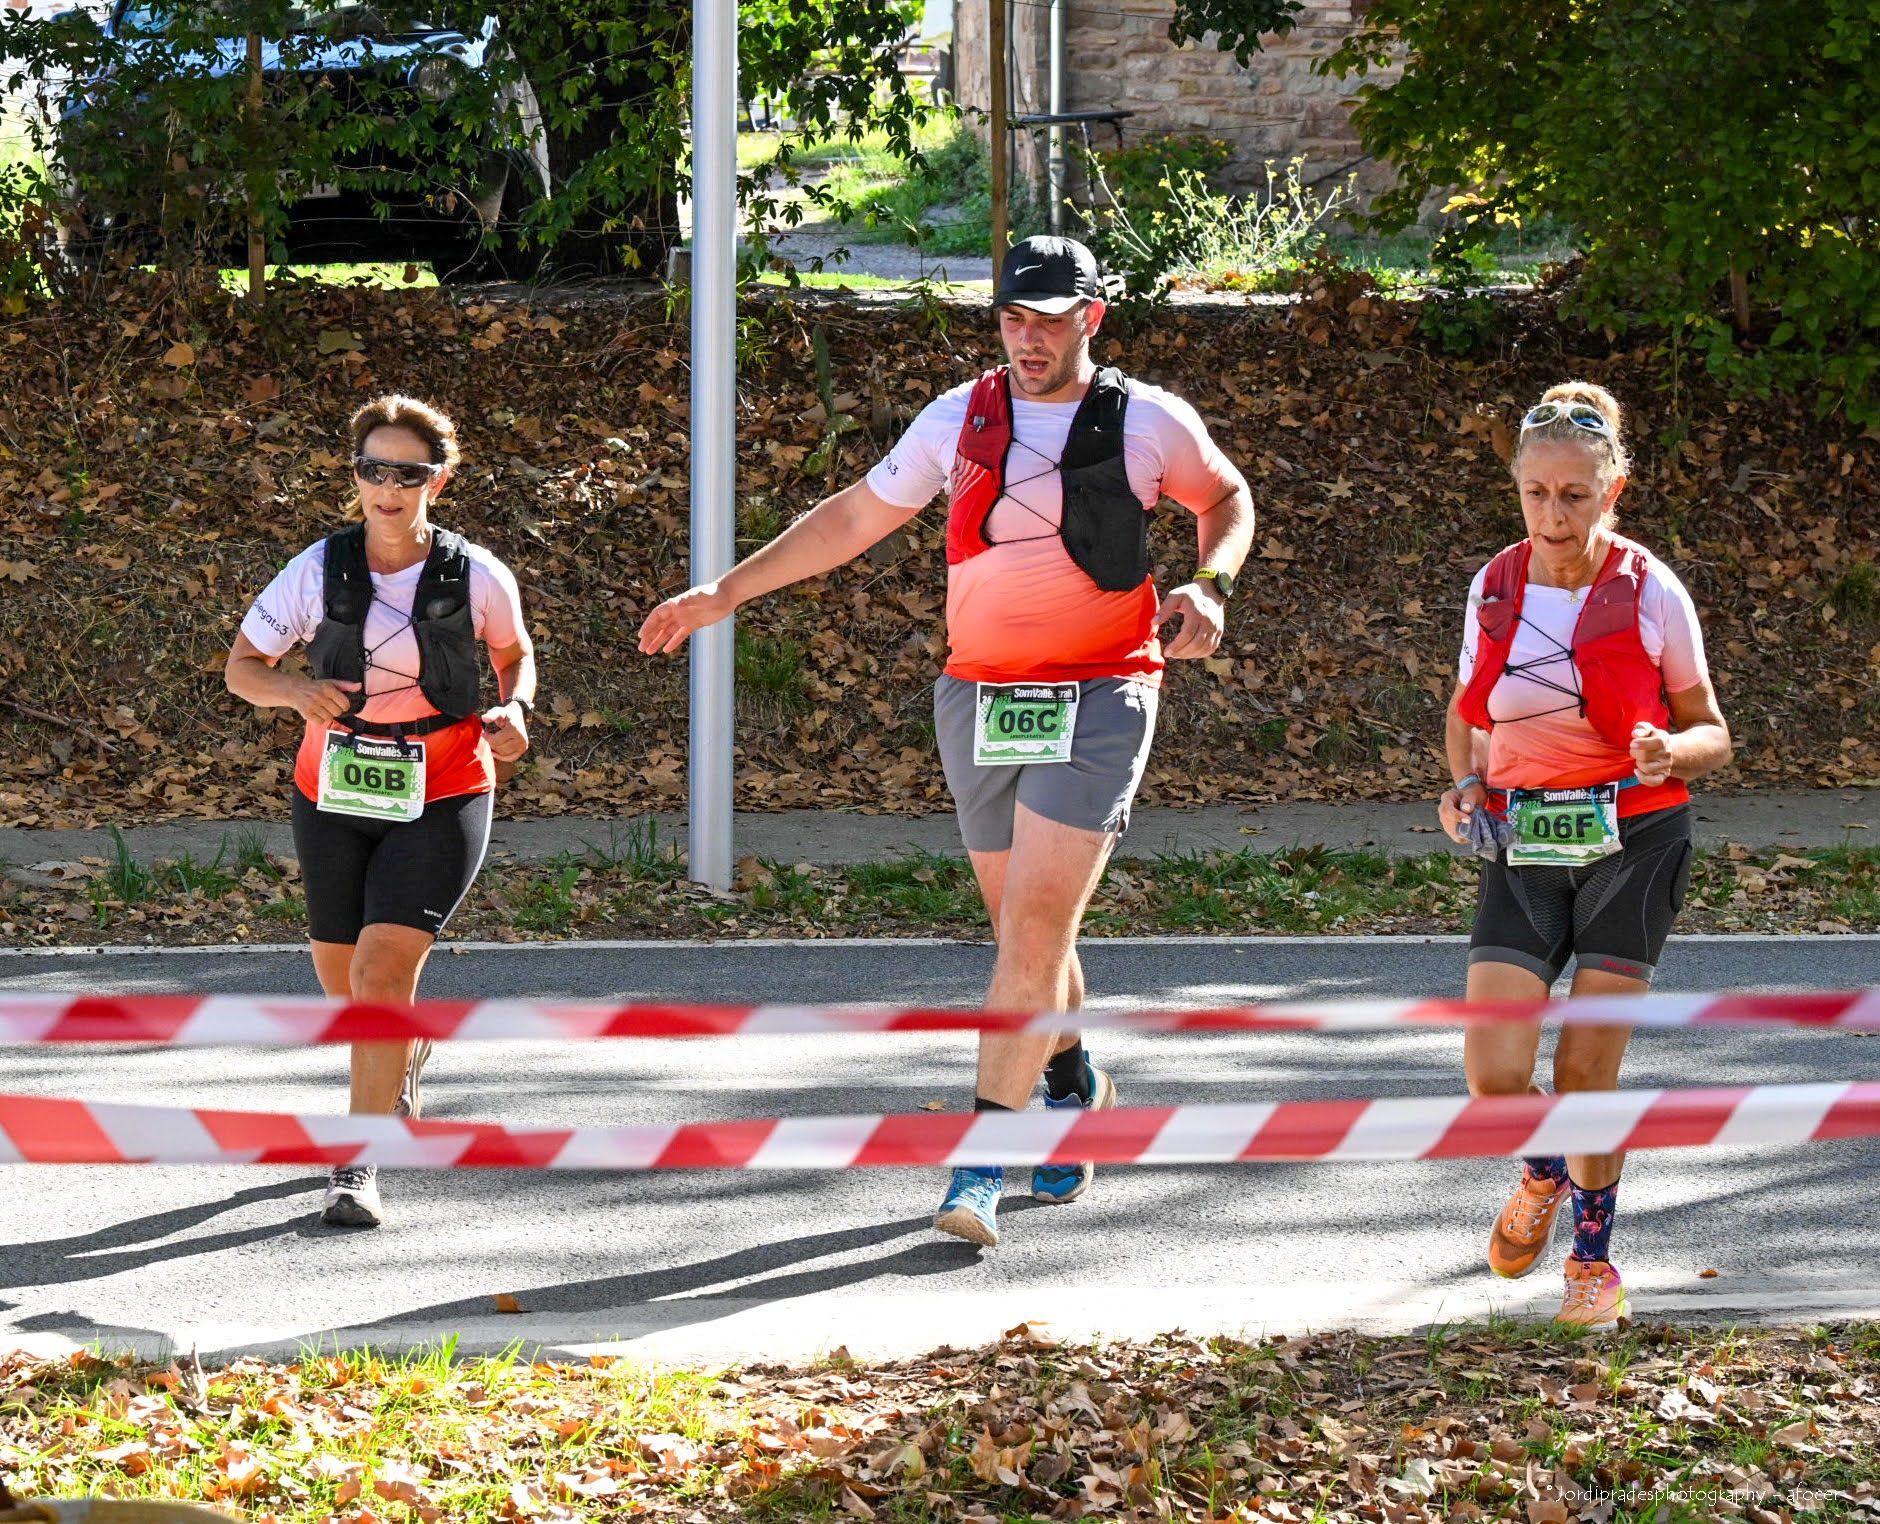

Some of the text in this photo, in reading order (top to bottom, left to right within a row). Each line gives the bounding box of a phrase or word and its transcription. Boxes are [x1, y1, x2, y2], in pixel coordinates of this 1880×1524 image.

[999, 710, 1058, 734] 06C
[344, 764, 406, 792] 06B
[1533, 813, 1595, 839] 06F
